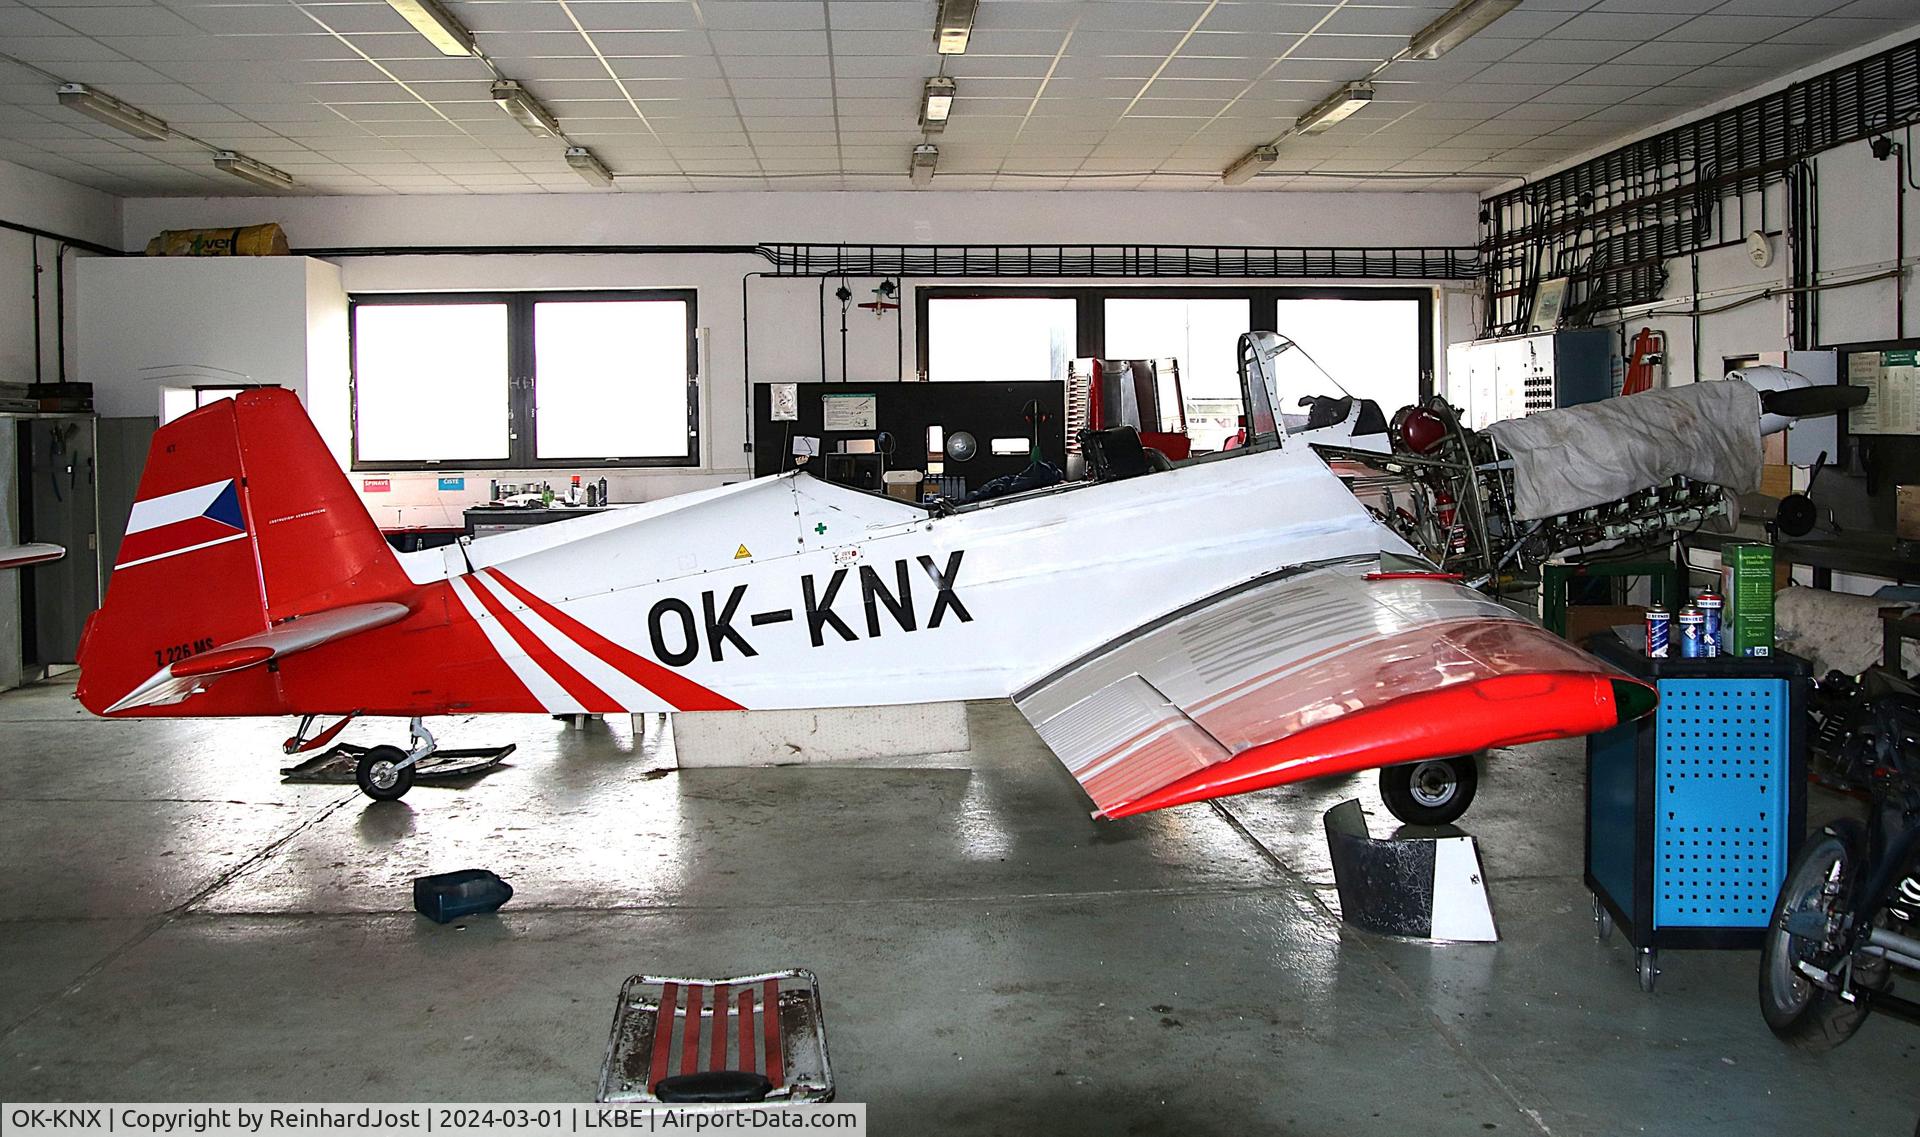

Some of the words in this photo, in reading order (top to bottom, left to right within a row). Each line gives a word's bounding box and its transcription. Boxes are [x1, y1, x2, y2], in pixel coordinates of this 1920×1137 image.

[647, 550, 974, 667] OK-KNX
[167, 643, 192, 664] 226
[193, 637, 214, 654] MS
